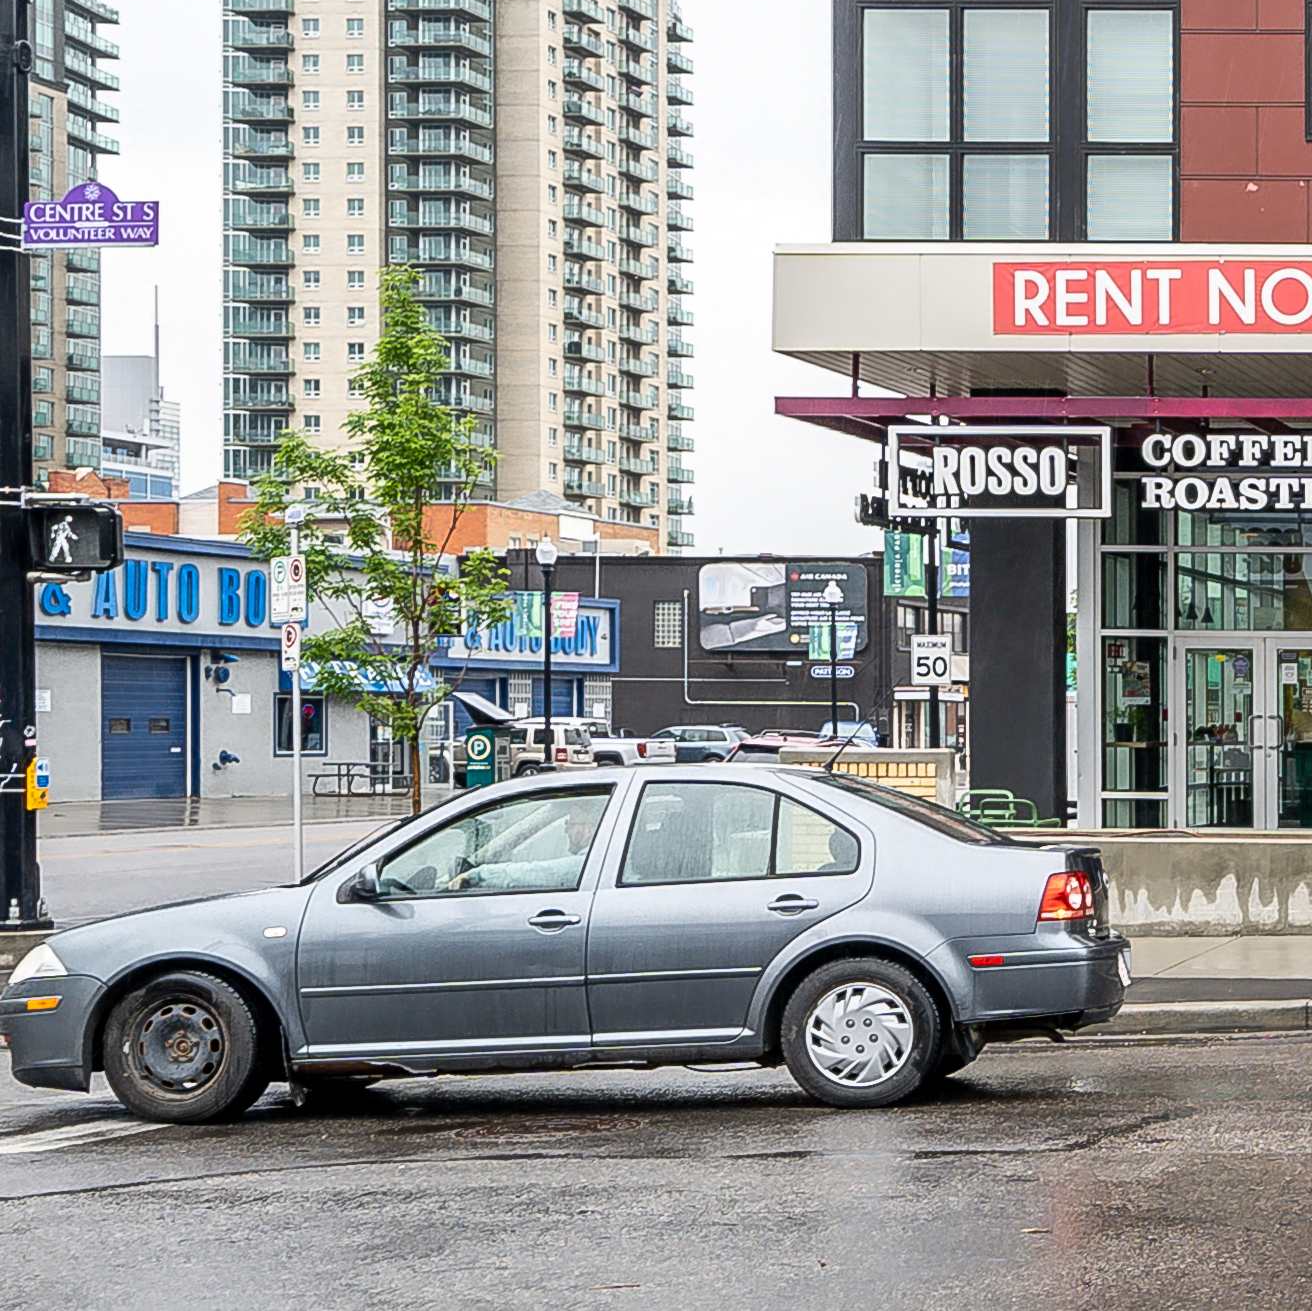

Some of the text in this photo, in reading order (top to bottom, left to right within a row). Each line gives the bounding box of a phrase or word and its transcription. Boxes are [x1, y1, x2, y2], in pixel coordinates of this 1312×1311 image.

[29, 202, 154, 222] CENTRE ST S
[29, 227, 153, 241] VOLUNTEER WAY
[1012, 269, 1183, 326] RENT
[932, 446, 1067, 496] ROSSO
[946, 563, 970, 576] BIT
[40, 582, 72, 616] &
[91, 559, 200, 624] AUTO
[916, 656, 948, 677] 50
